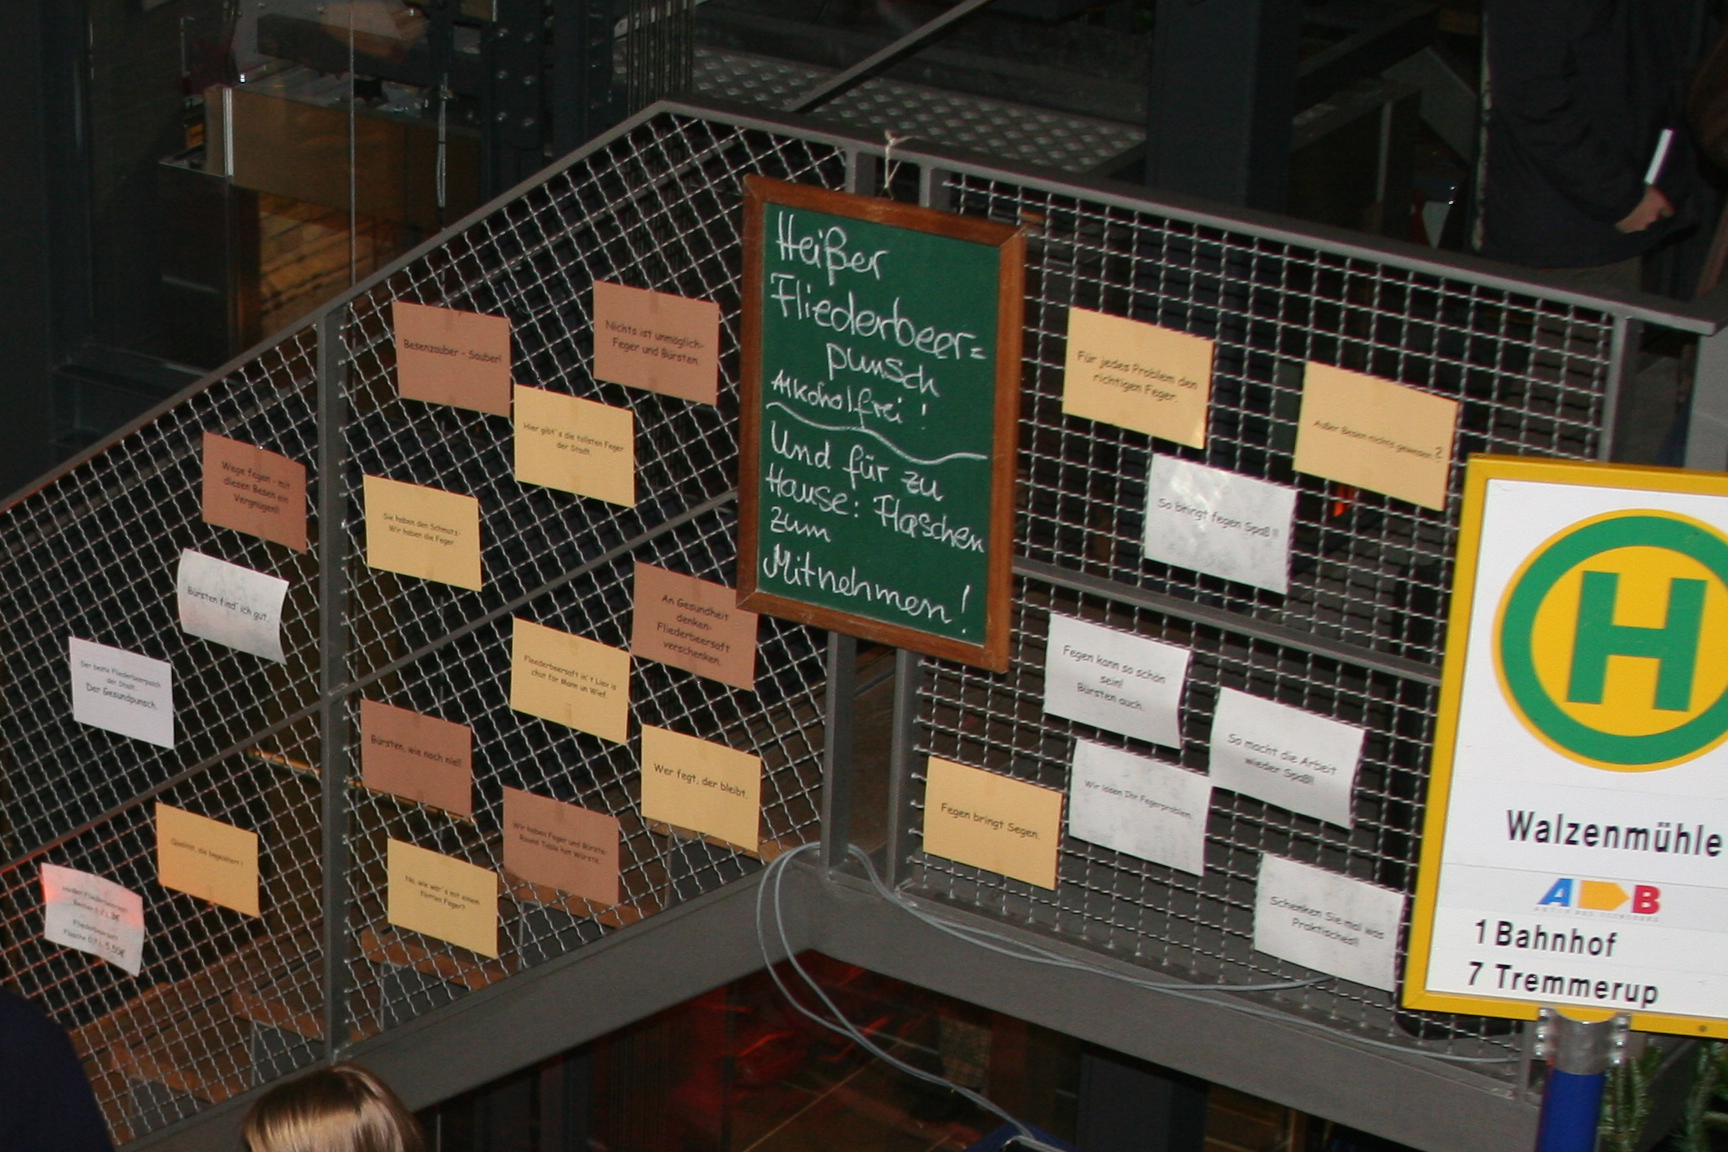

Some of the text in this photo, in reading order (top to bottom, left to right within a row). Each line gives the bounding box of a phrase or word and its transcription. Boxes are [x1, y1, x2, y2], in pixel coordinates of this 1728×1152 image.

[776, 210, 890, 287] Heißer
[404, 339, 459, 357] Besenzauber
[612, 337, 640, 353] Feger
[642, 347, 659, 357] und
[1077, 350, 1198, 390] Für jedes Problem den
[1092, 373, 1143, 393] richtigen
[771, 421, 944, 503] Und für zu
[771, 507, 831, 544] zum
[873, 494, 985, 554] Flaschen
[1157, 497, 1173, 511] So
[1211, 511, 1242, 530] fegen
[661, 594, 729, 621] An Gesundheit
[657, 622, 730, 653] Fliederbeersaft
[1566, 570, 1709, 712] H
[1063, 645, 1093, 662] Fegen
[1096, 654, 1119, 671] kann
[1121, 664, 1133, 675] so
[1077, 682, 1117, 703] Bürsten
[1227, 733, 1337, 776] So macht die Arbeit
[1244, 757, 1281, 773] wieder
[654, 763, 673, 775] Wer
[701, 777, 718, 788] der
[941, 802, 971, 819] Fegen
[974, 812, 1004, 830] bringt
[1507, 809, 1722, 857] Walzenmühle
[1269, 896, 1322, 917] Schenken
[1324, 911, 1342, 925] Sie
[1364, 925, 1385, 940] was
[1475, 919, 1618, 957] 1 Bahnhof
[1468, 961, 1659, 1007] 7 Tremmerup
